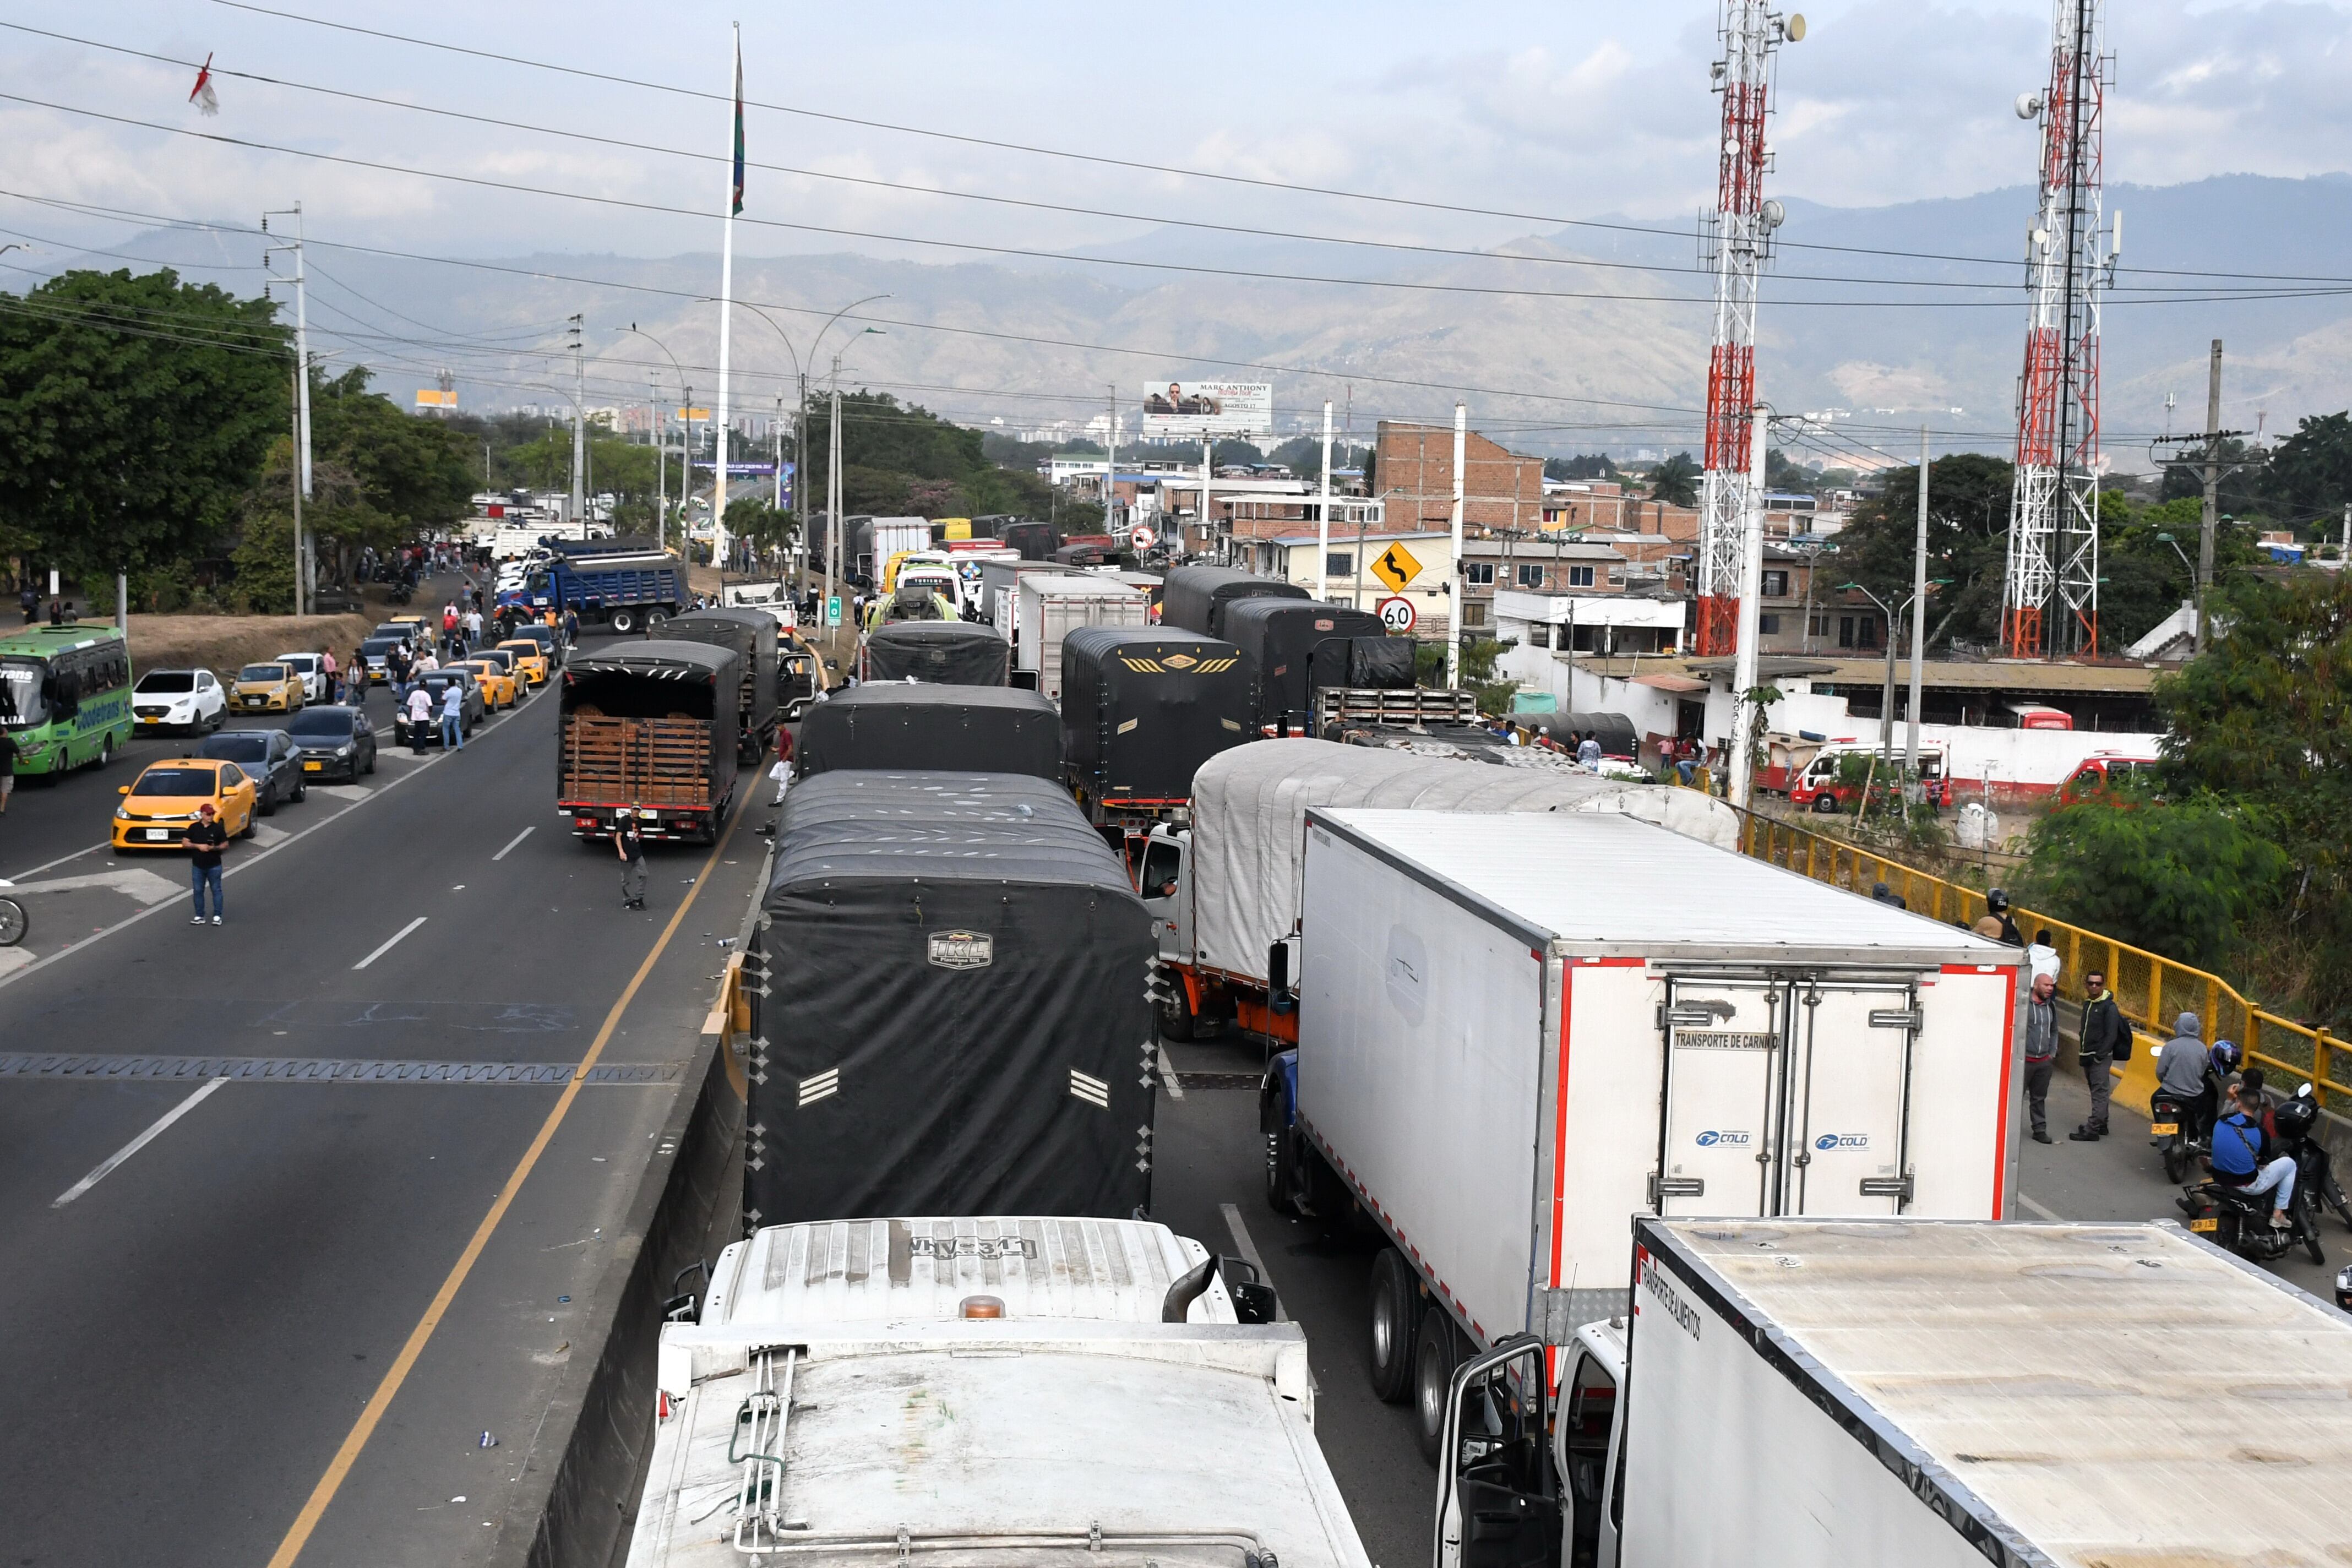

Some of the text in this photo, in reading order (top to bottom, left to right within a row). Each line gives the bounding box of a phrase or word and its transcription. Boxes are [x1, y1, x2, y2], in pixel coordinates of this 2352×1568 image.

[1385, 607, 1408, 625] 60
[937, 941, 984, 957] IKL
[1675, 1033, 1728, 1048] TRANSPORTE
[1730, 1035, 1741, 1048] DE
[1720, 1134, 1749, 1144] COLD
[1839, 1137, 1868, 1146] COLD
[1641, 1261, 1701, 1342] TRANSPORTE DE ALIMENTOS
